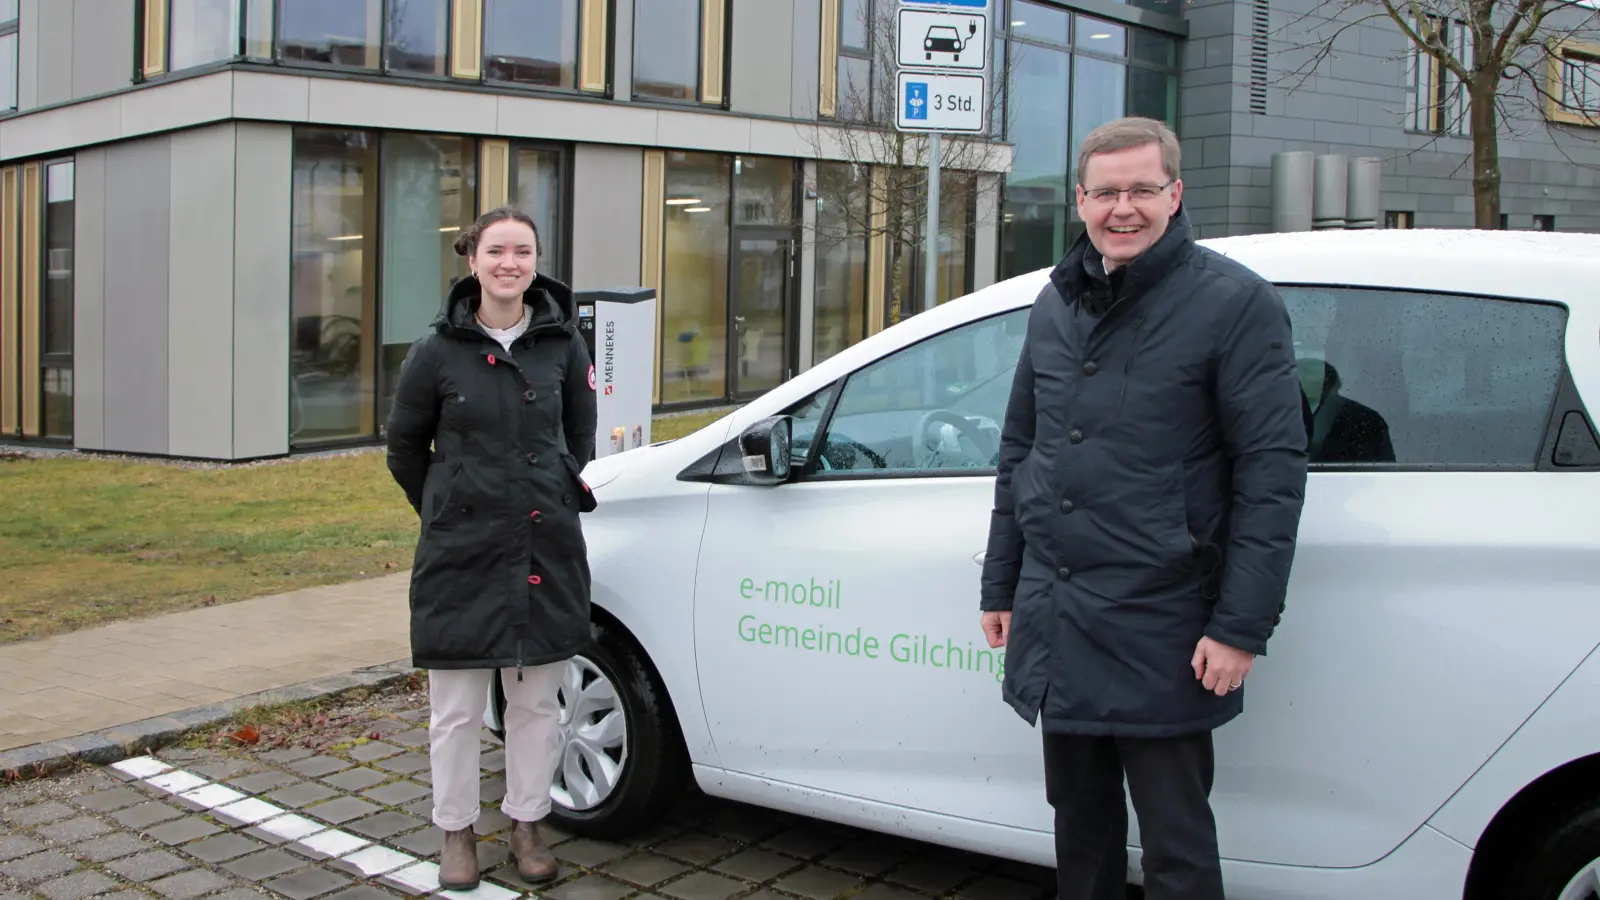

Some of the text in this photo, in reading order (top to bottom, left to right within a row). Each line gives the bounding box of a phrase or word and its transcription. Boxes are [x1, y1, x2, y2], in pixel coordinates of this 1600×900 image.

[934, 94, 975, 112] 3 Std.
[605, 320, 614, 383] MENNEKES
[739, 577, 841, 609] e-mobil
[738, 615, 880, 659] Gemeinde
